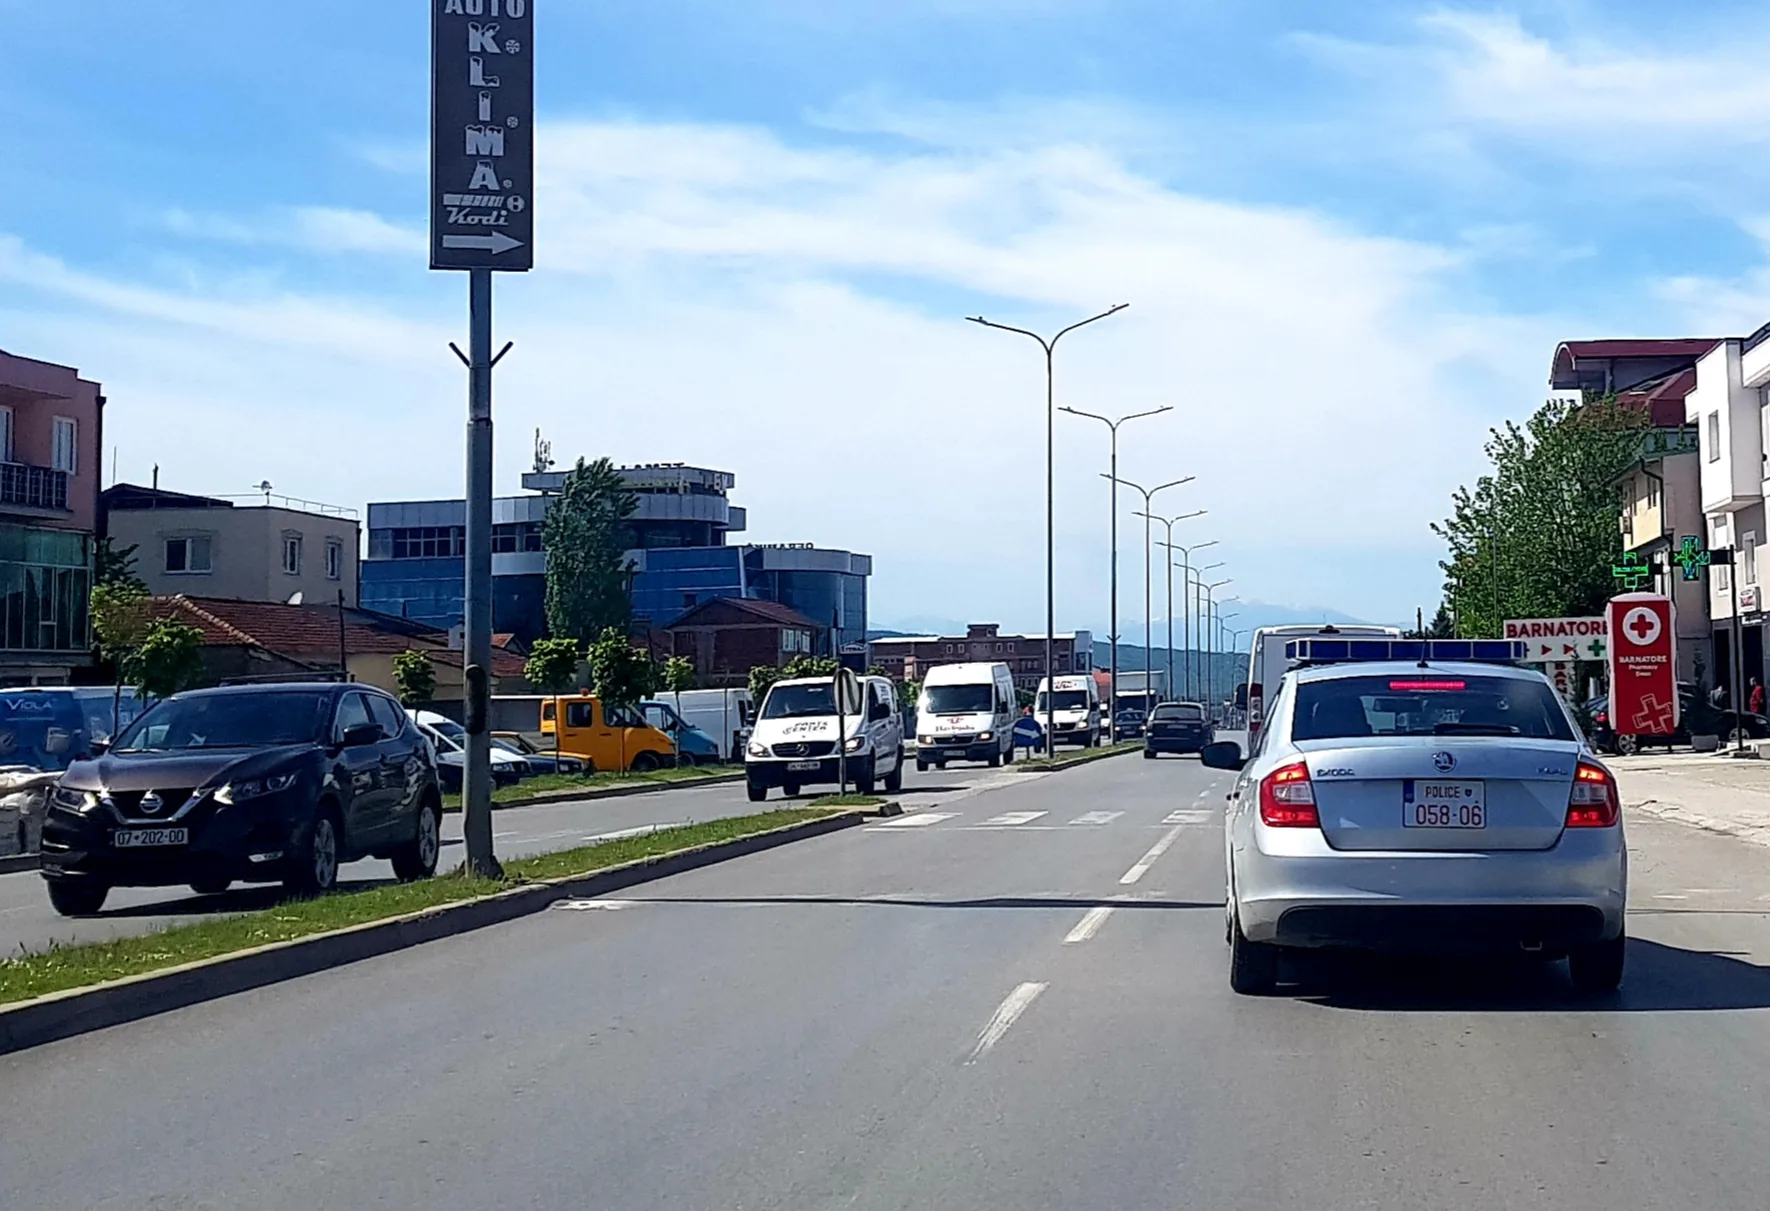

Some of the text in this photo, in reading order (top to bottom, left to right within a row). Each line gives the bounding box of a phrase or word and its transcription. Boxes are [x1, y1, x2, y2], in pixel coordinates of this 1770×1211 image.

[444, 0, 525, 18] AUTO
[1618, 655, 1668, 664] BARNATORE
[1425, 786, 1461, 798] POLICE
[1416, 804, 1482, 826] 058-06
